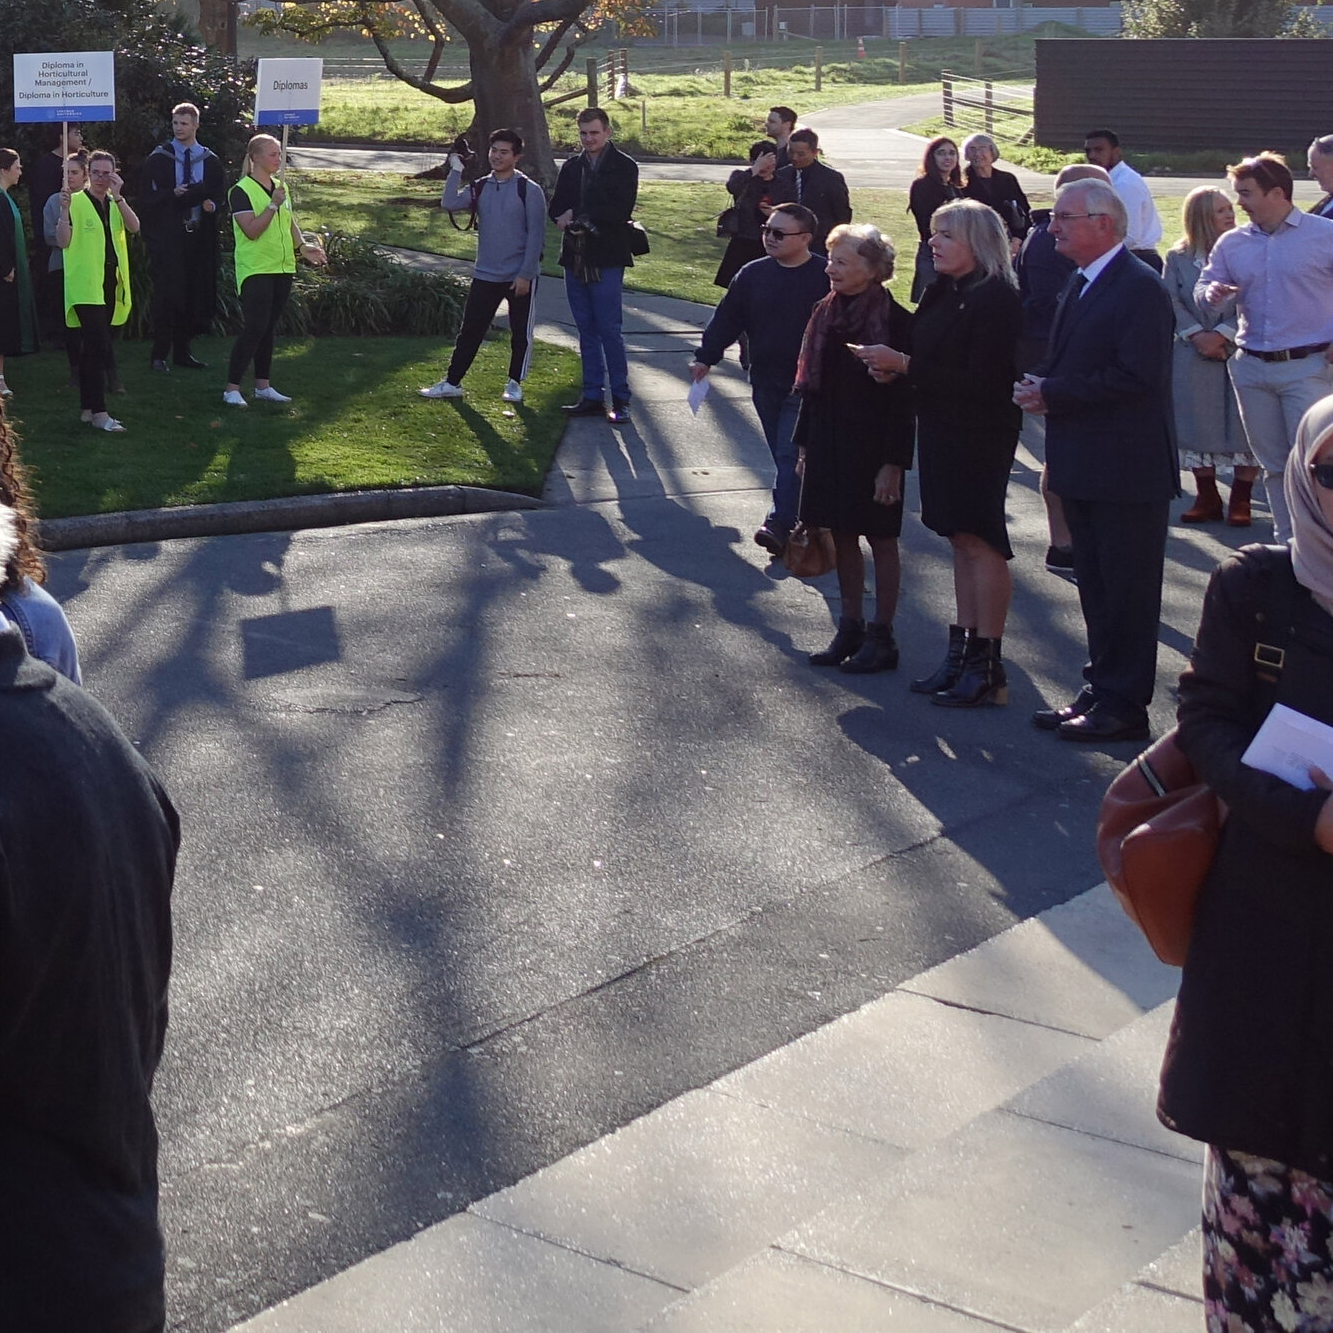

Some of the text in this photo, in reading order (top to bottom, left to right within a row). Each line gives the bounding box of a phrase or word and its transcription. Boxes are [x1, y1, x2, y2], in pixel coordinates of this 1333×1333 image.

[42, 61, 75, 70] Diploma
[38, 69, 88, 78] Horticultural
[35, 78, 86, 87] Management
[273, 80, 308, 91] Diplomas
[19, 91, 51, 100] Diploma
[61, 90, 109, 98] Horticulture
